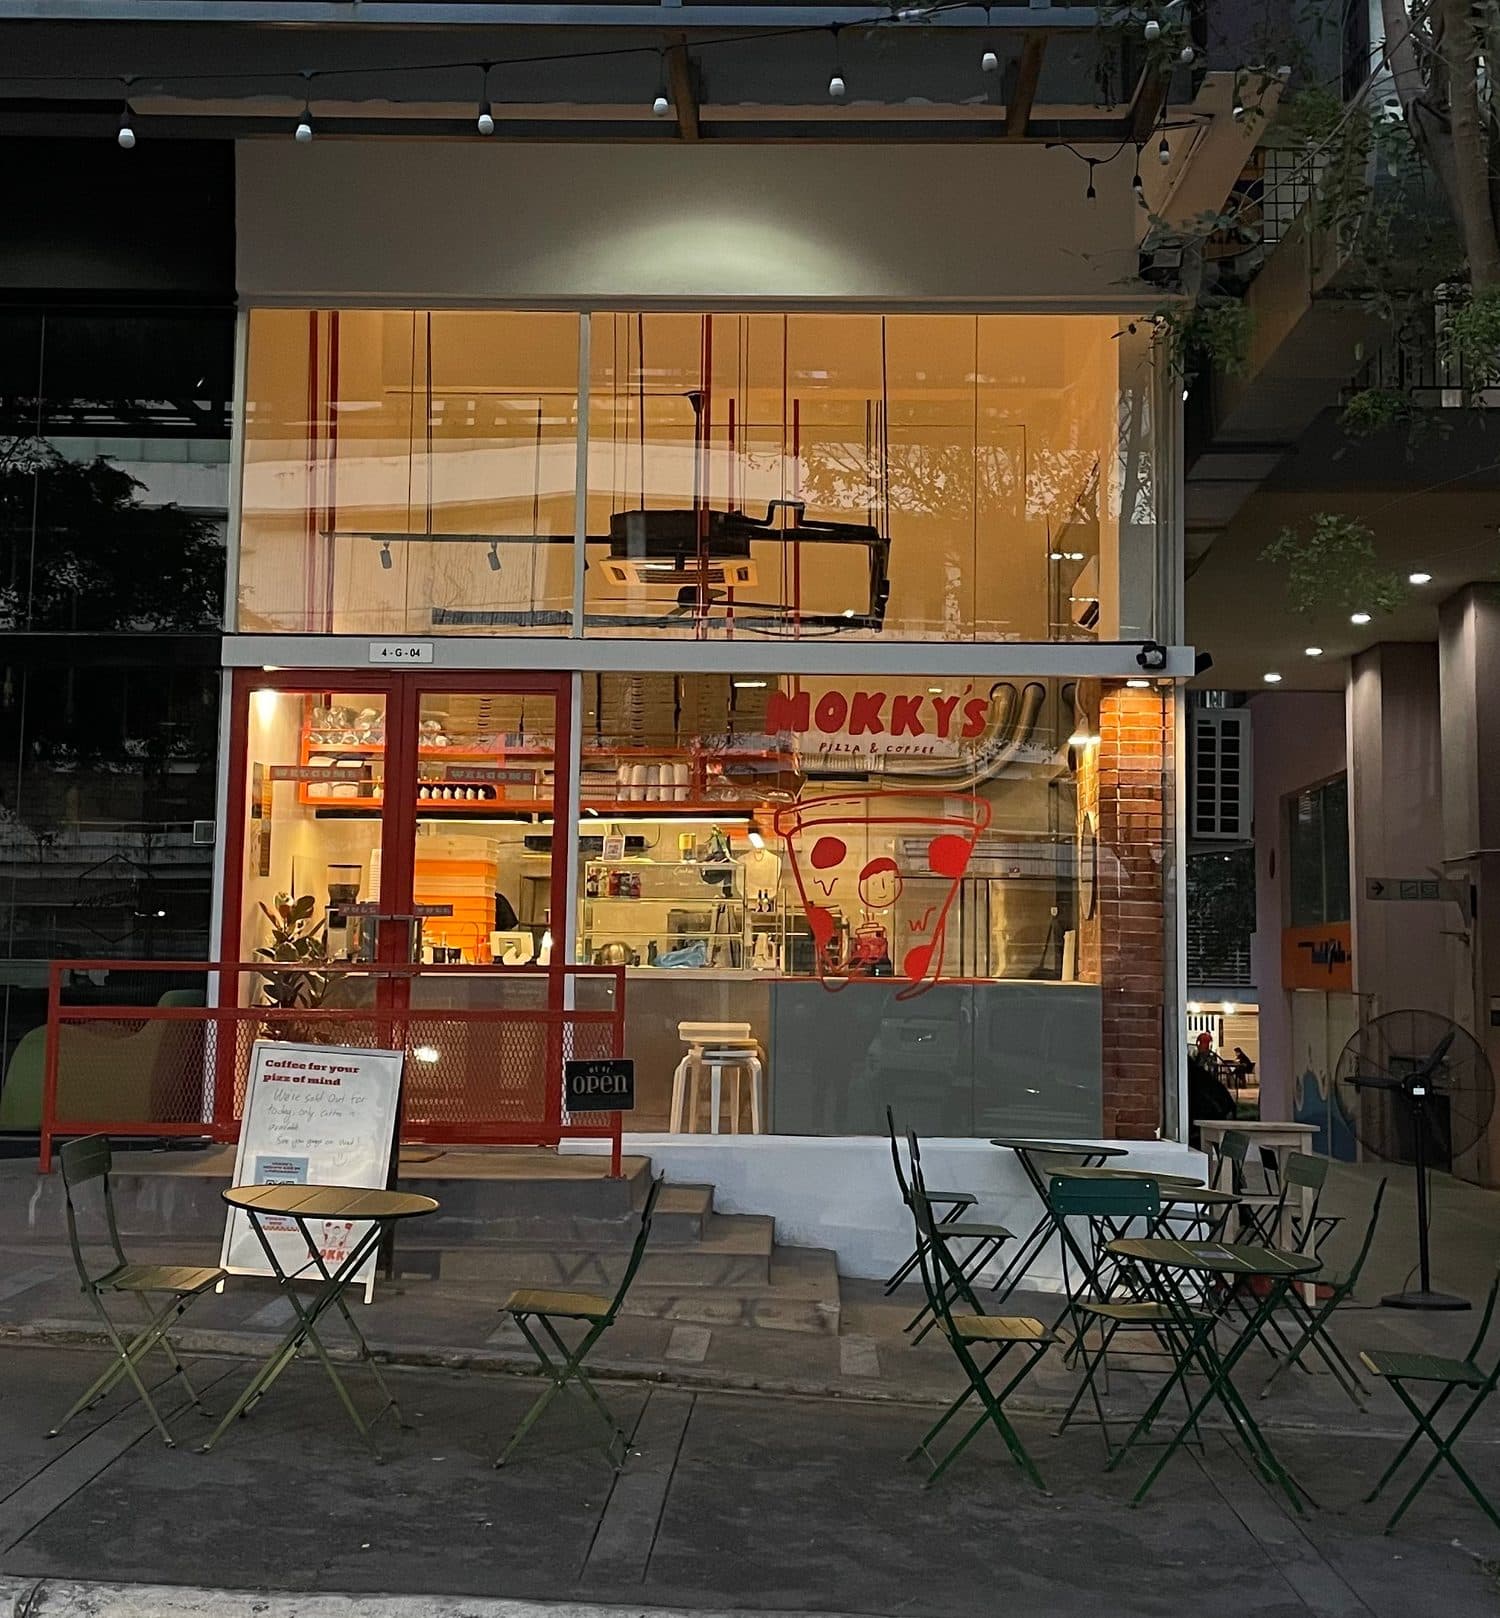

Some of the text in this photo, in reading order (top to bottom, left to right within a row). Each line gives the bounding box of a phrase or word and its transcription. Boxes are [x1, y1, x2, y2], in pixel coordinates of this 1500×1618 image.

[765, 685, 989, 738] MOKKY'S
[819, 742, 935, 755] PIZZA & COFFEE
[450, 769, 533, 781] WELCOME
[265, 1060, 360, 1074] Coffee for your
[292, 1075, 307, 1083] of
[308, 1077, 341, 1086] mind
[572, 1074, 628, 1094] open
